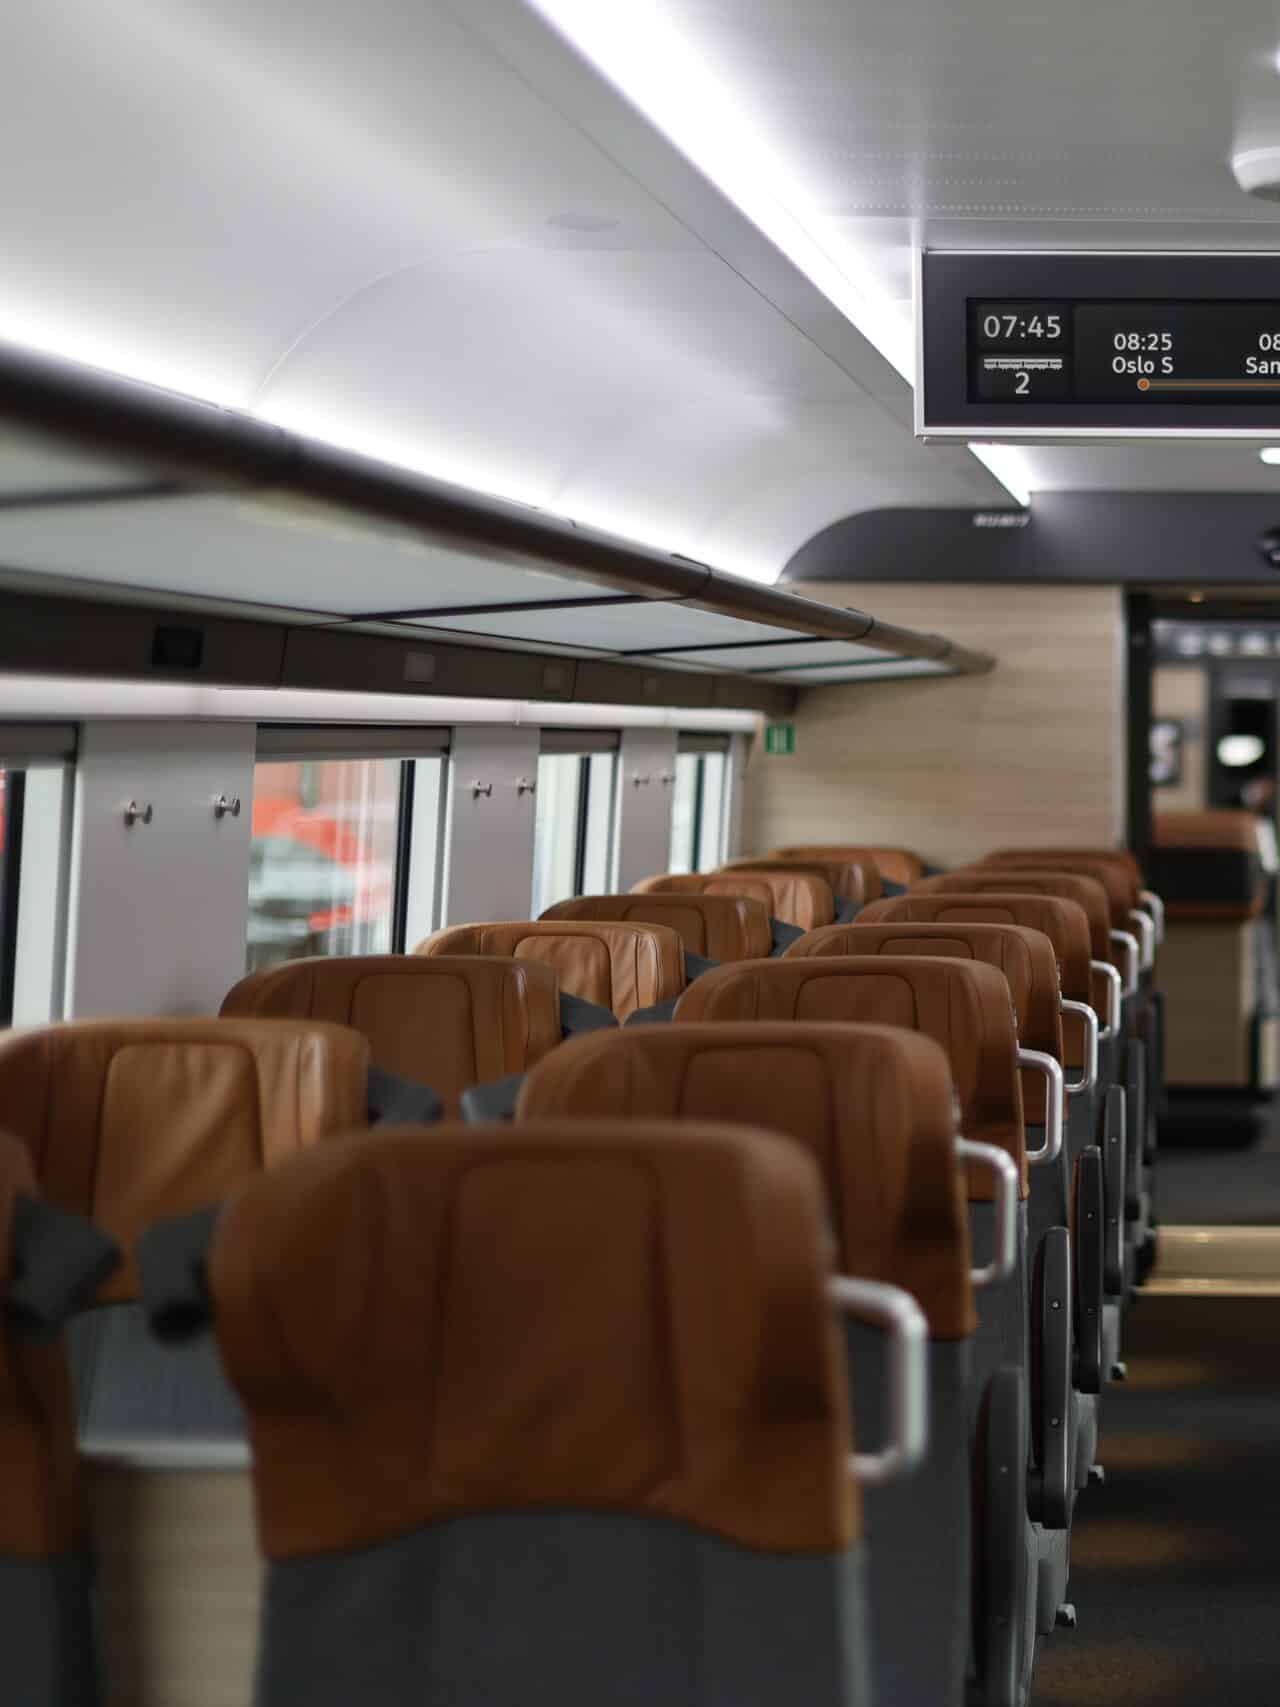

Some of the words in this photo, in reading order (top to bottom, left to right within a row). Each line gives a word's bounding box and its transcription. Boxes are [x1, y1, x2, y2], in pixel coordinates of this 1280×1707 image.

[983, 315, 1061, 339] 07:45
[1113, 332, 1173, 351] 08:25
[1111, 354, 1155, 375] Oslo
[1161, 356, 1174, 374] S
[1014, 371, 1031, 395] 2
